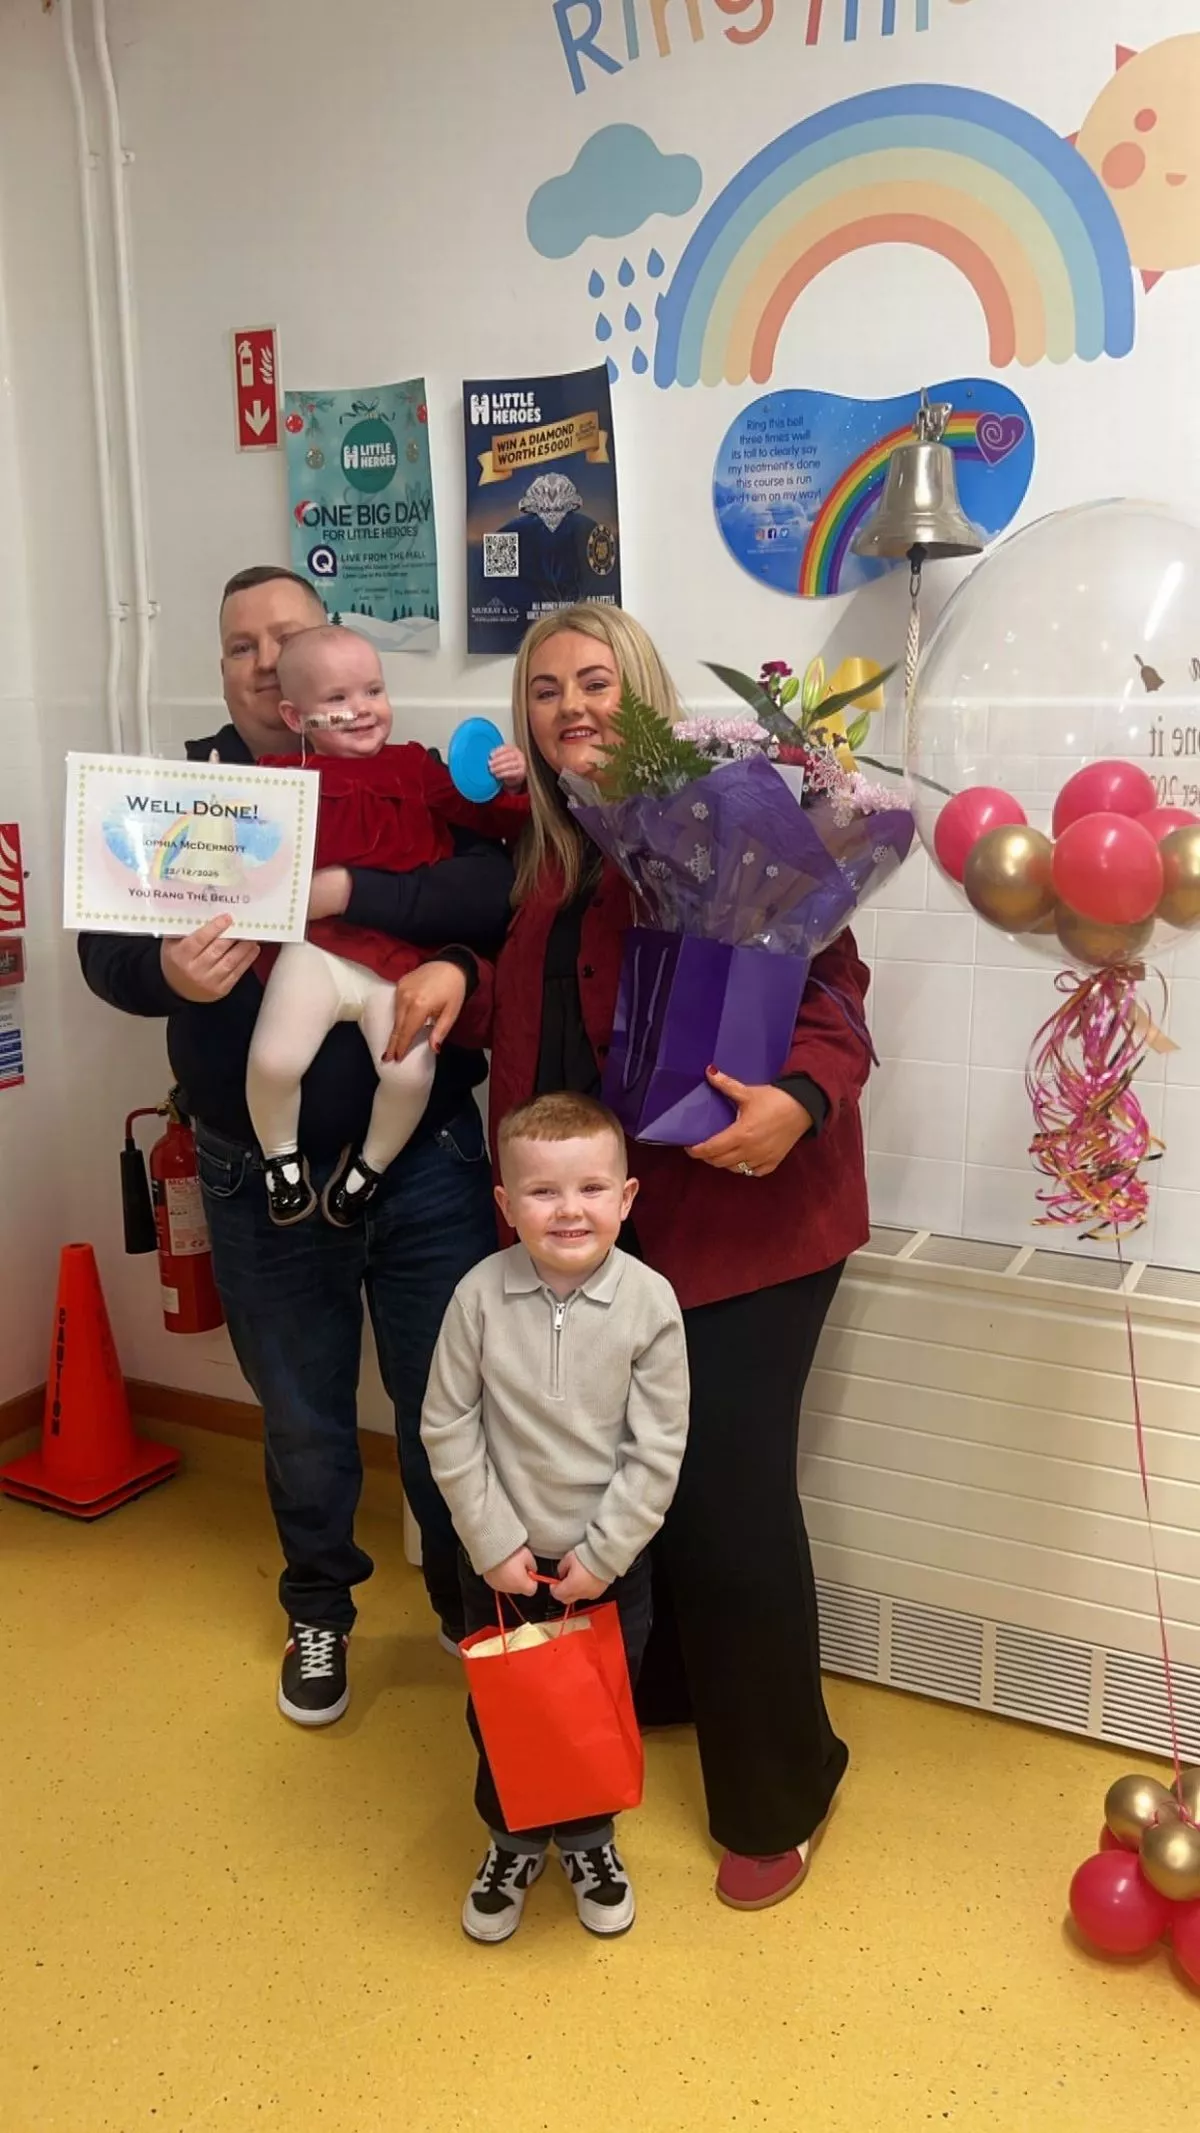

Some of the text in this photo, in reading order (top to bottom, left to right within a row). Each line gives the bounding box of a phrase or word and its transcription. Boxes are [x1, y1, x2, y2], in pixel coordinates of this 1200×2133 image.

[492, 392, 535, 408] LITTLE
[492, 407, 541, 425] HEROES
[746, 415, 804, 433] Ring this bell
[497, 440, 517, 453] WIN
[519, 436, 527, 447] A
[528, 423, 575, 444] DIAMOND
[740, 434, 763, 446] three
[765, 432, 789, 443] times
[360, 442, 391, 456] LITTLE
[498, 438, 574, 465] WORTH £5000!
[759, 446, 767, 458] to
[769, 444, 799, 457] clearly
[801, 445, 818, 456] say
[360, 454, 396, 468] HEROES
[728, 459, 821, 476] my treatment's done
[736, 475, 812, 489] this course is run
[768, 492, 781, 501] on
[783, 491, 797, 502] my
[303, 499, 432, 527] ONE BIG DAY
[322, 526, 418, 540] FOR LITTLE HEROES
[341, 552, 360, 562] LIVE
[362, 551, 387, 562] FROM
[389, 550, 405, 561] THE
[126, 795, 258, 820] WELL DONE!
[143, 839, 177, 849] OPHIA
[128, 887, 240, 904] YOU RANG THE BELL!
